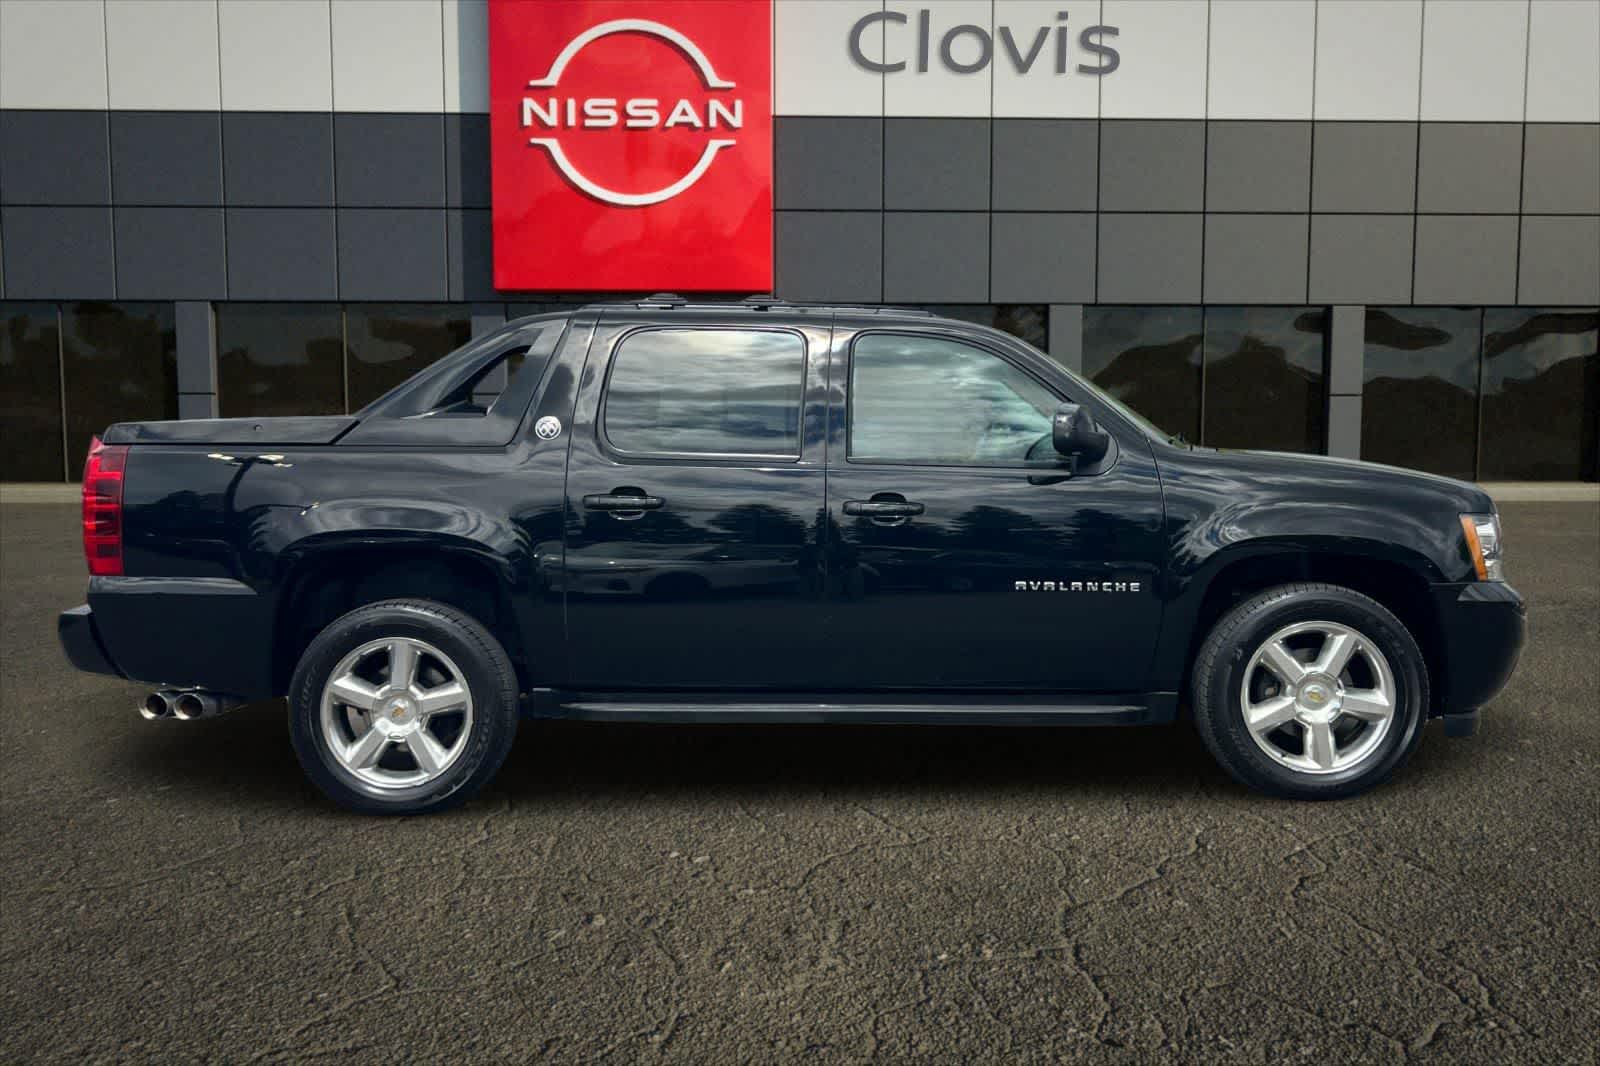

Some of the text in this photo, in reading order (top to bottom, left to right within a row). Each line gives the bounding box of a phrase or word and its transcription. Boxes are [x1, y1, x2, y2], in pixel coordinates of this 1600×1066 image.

[849, 9, 1121, 75] Clovis
[522, 97, 744, 128] NISSAN
[1014, 580, 1141, 592] AVALANCHE
